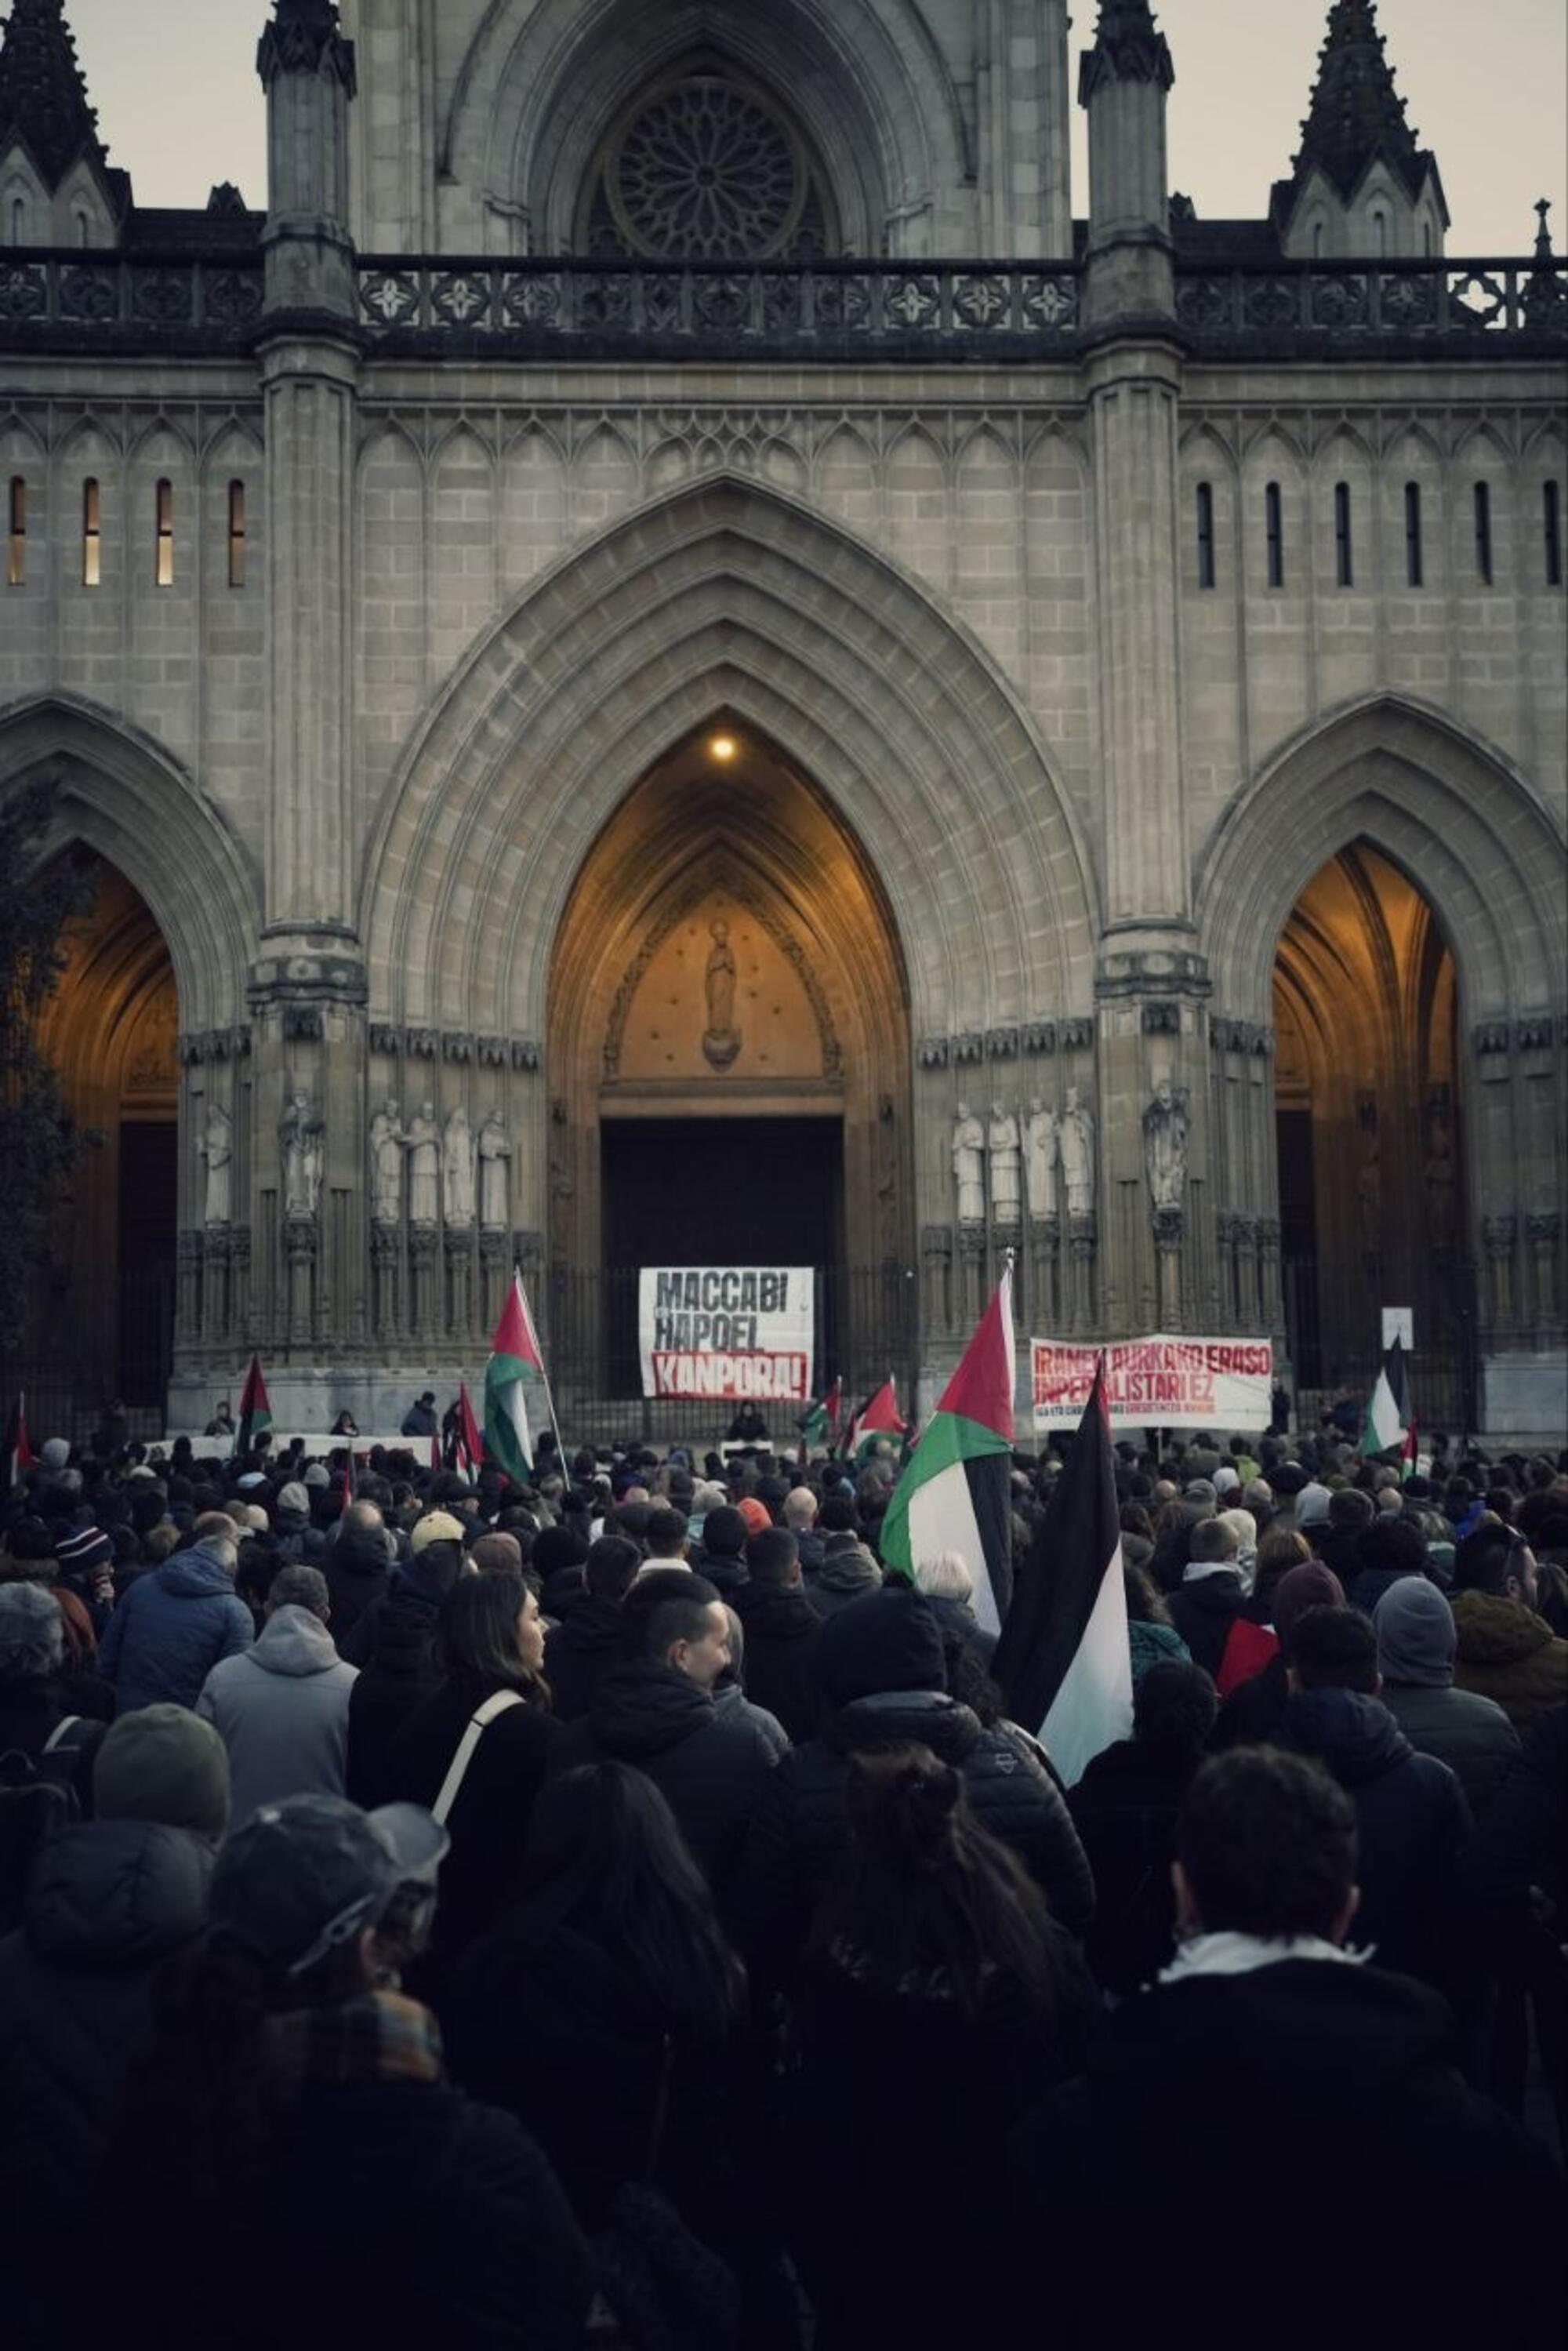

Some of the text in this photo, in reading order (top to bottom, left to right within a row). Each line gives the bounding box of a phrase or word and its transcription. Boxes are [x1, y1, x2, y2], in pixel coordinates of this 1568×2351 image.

[656, 1271, 788, 1312] MACCABI
[654, 1313, 764, 1351] HAPOEL
[656, 1355, 800, 1398] KANPORA!
[1111, 1343, 1203, 1372] AURKAKO
[1207, 1346, 1269, 1375] ERASO
[1192, 1375, 1214, 1401] EZ
